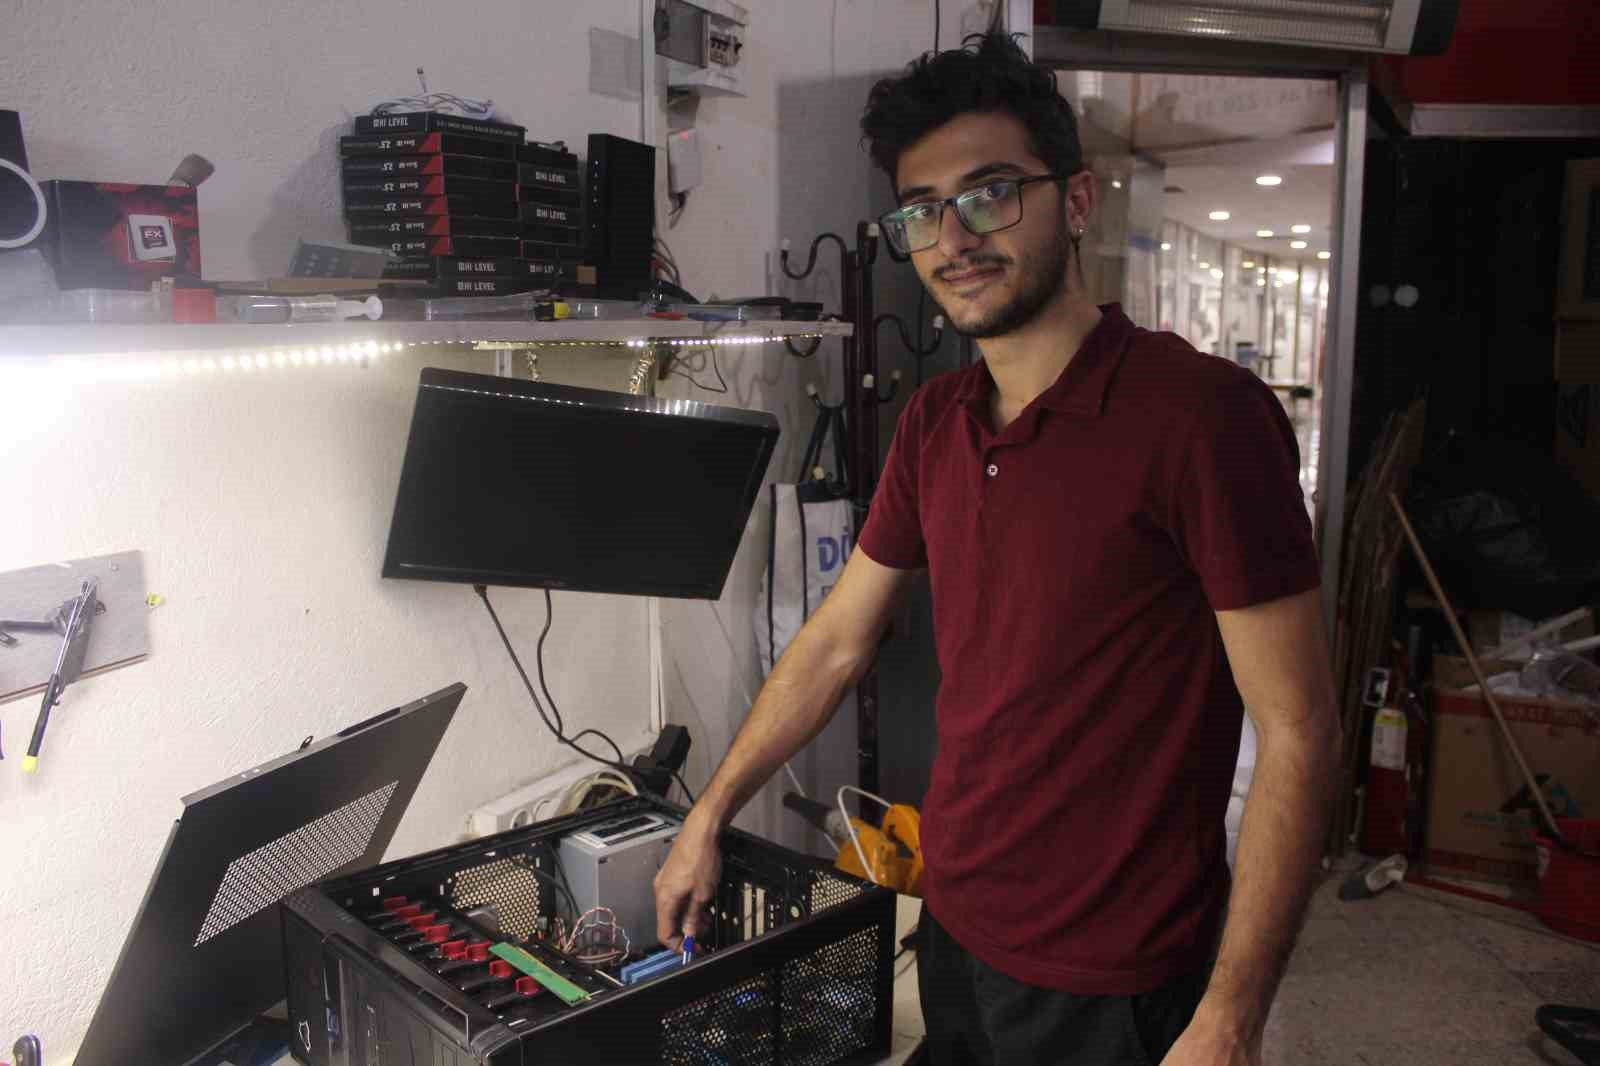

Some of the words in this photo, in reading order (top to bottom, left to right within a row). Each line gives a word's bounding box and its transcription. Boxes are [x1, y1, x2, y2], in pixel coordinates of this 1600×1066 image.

[388, 117, 409, 127] LEVEL
[549, 172, 567, 184] LEVEL
[549, 209, 567, 220] LEVEL
[144, 231, 162, 239] FX
[474, 262, 496, 272] LEVEL
[474, 281, 496, 291] LEVEL
